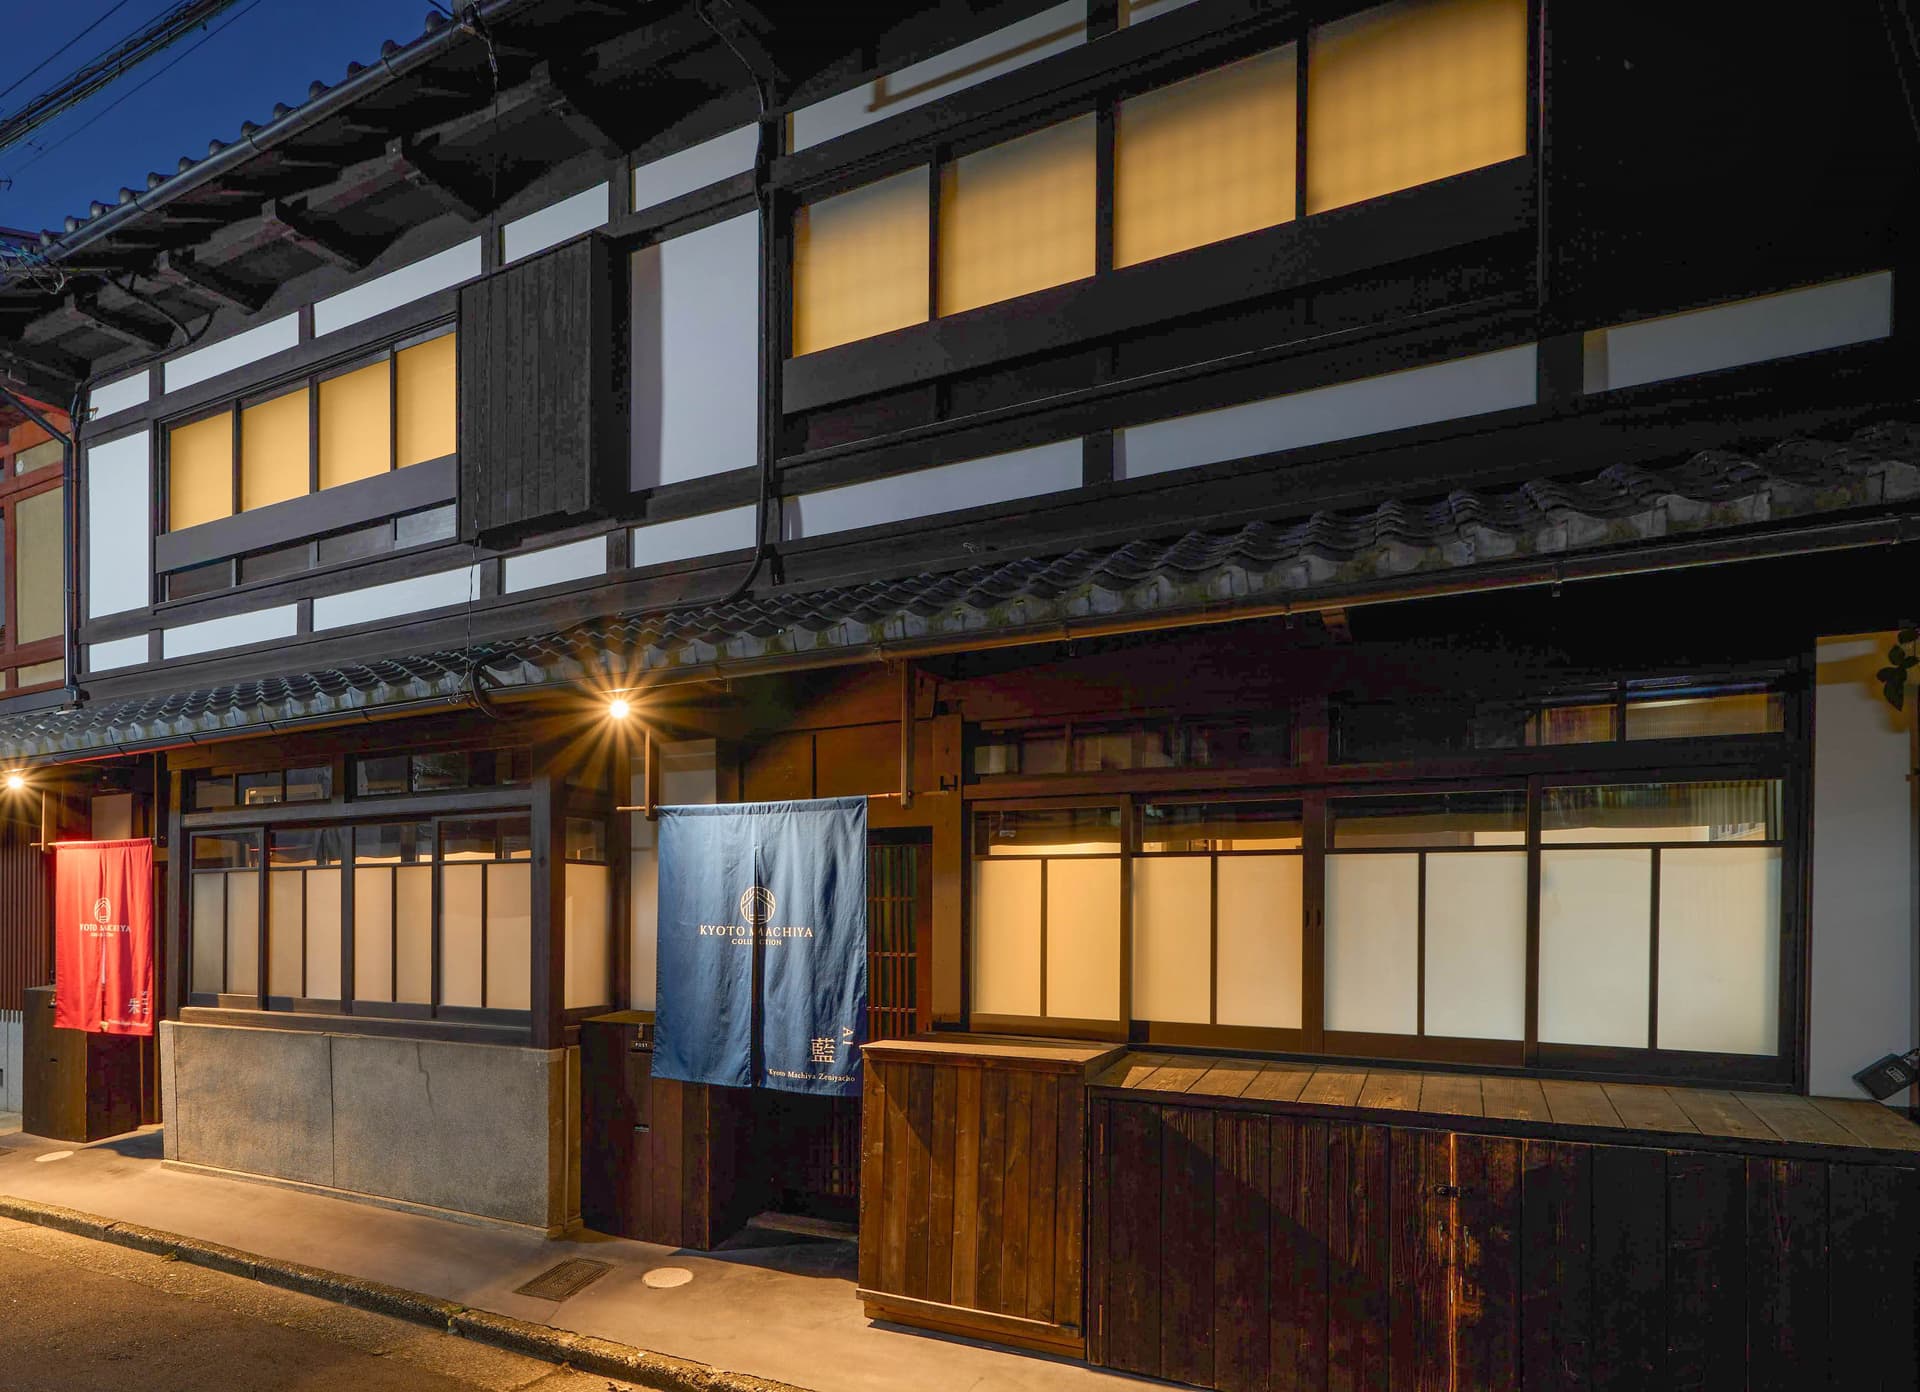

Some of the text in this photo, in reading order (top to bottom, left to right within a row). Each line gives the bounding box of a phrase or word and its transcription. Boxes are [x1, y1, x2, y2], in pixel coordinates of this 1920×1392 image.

[700, 924, 813, 937] KYOTO MACHIYA
[127, 997, 140, 1014] 朱
[842, 1027, 854, 1045] AI
[810, 1037, 835, 1063] 藍
[769, 1068, 855, 1082] Kyoto Machiya Zeniyacho
